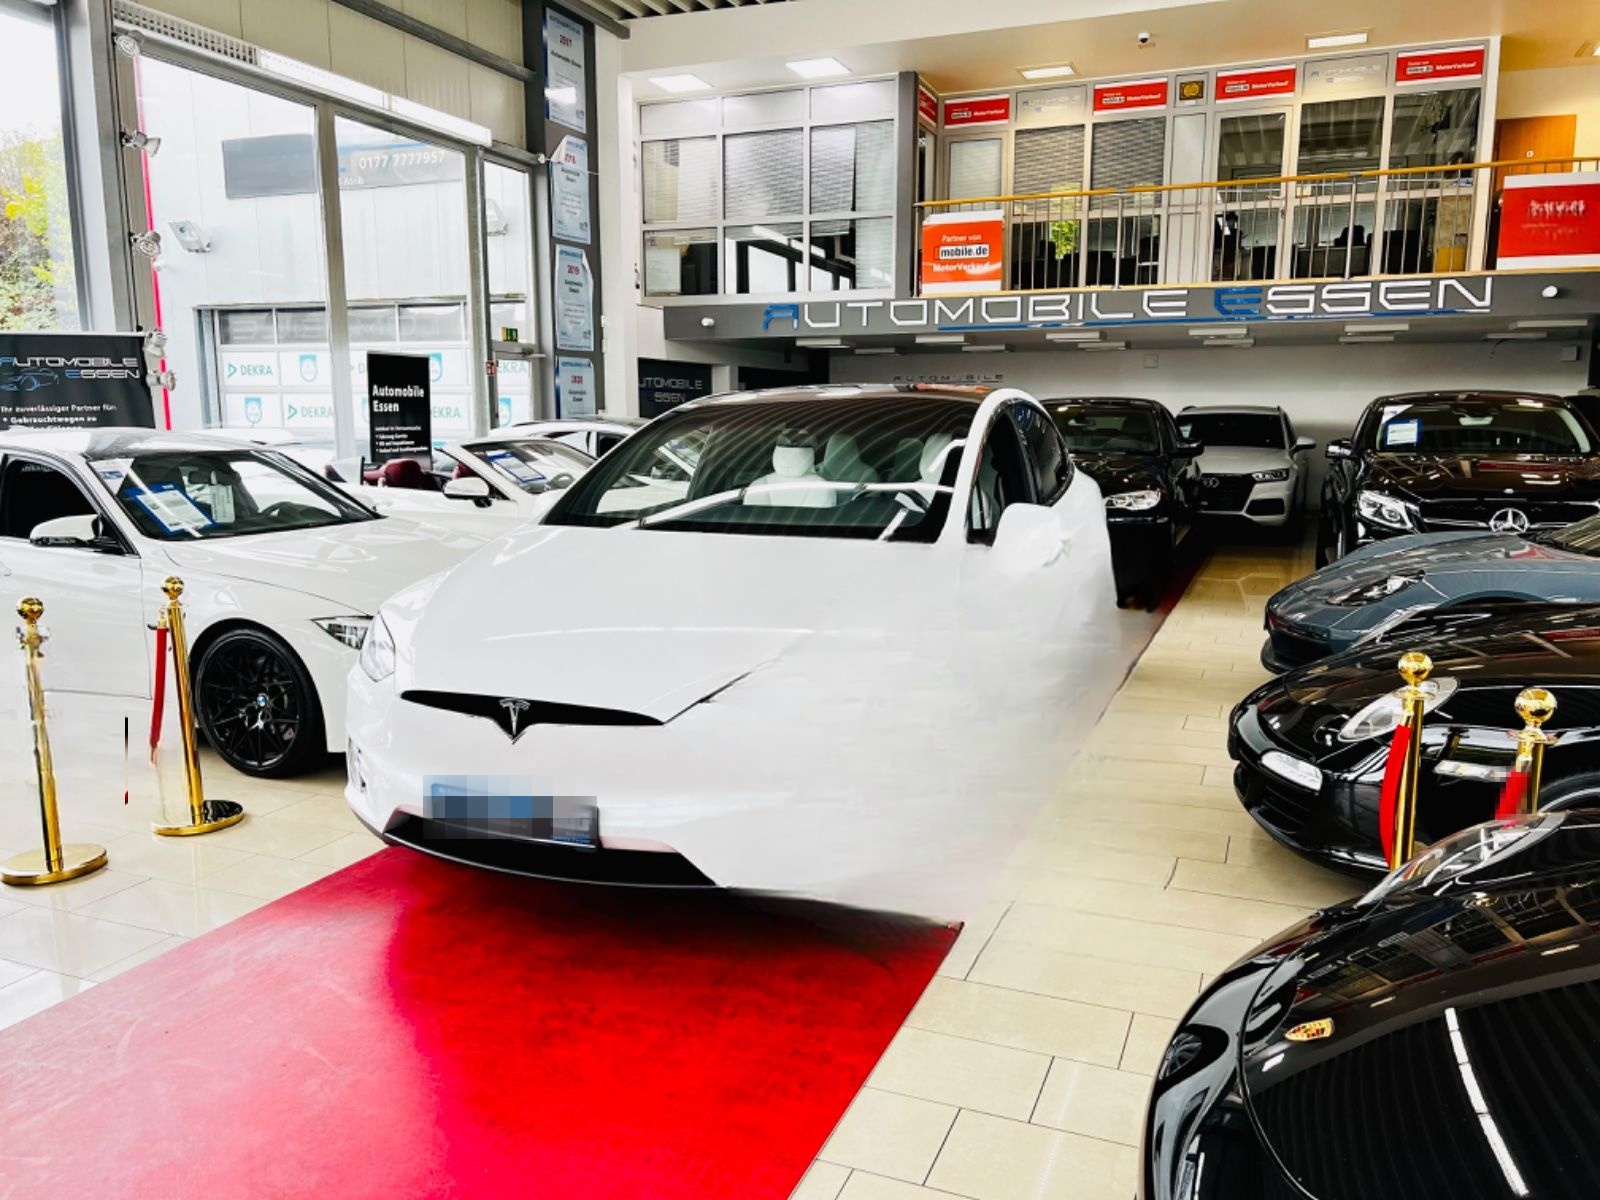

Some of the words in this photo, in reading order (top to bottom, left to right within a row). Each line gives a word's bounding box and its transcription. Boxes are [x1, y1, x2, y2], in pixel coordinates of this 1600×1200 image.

[942, 234, 967, 243] Partner
[940, 246, 988, 258] mobile.de
[762, 288, 1188, 331] AUTOMOBILE
[1213, 276, 1493, 315] ESSEN
[0, 356, 139, 368] AUTOMOBILE
[498, 361, 528, 374] EKRA
[65, 369, 140, 379] ESSEN
[240, 364, 273, 376] DEKRA
[893, 374, 1003, 382] AUTOMBILE
[372, 384, 425, 398] Automobile
[70, 404, 101, 412] Partner
[372, 400, 400, 412] Essen
[433, 406, 461, 418] EKRA
